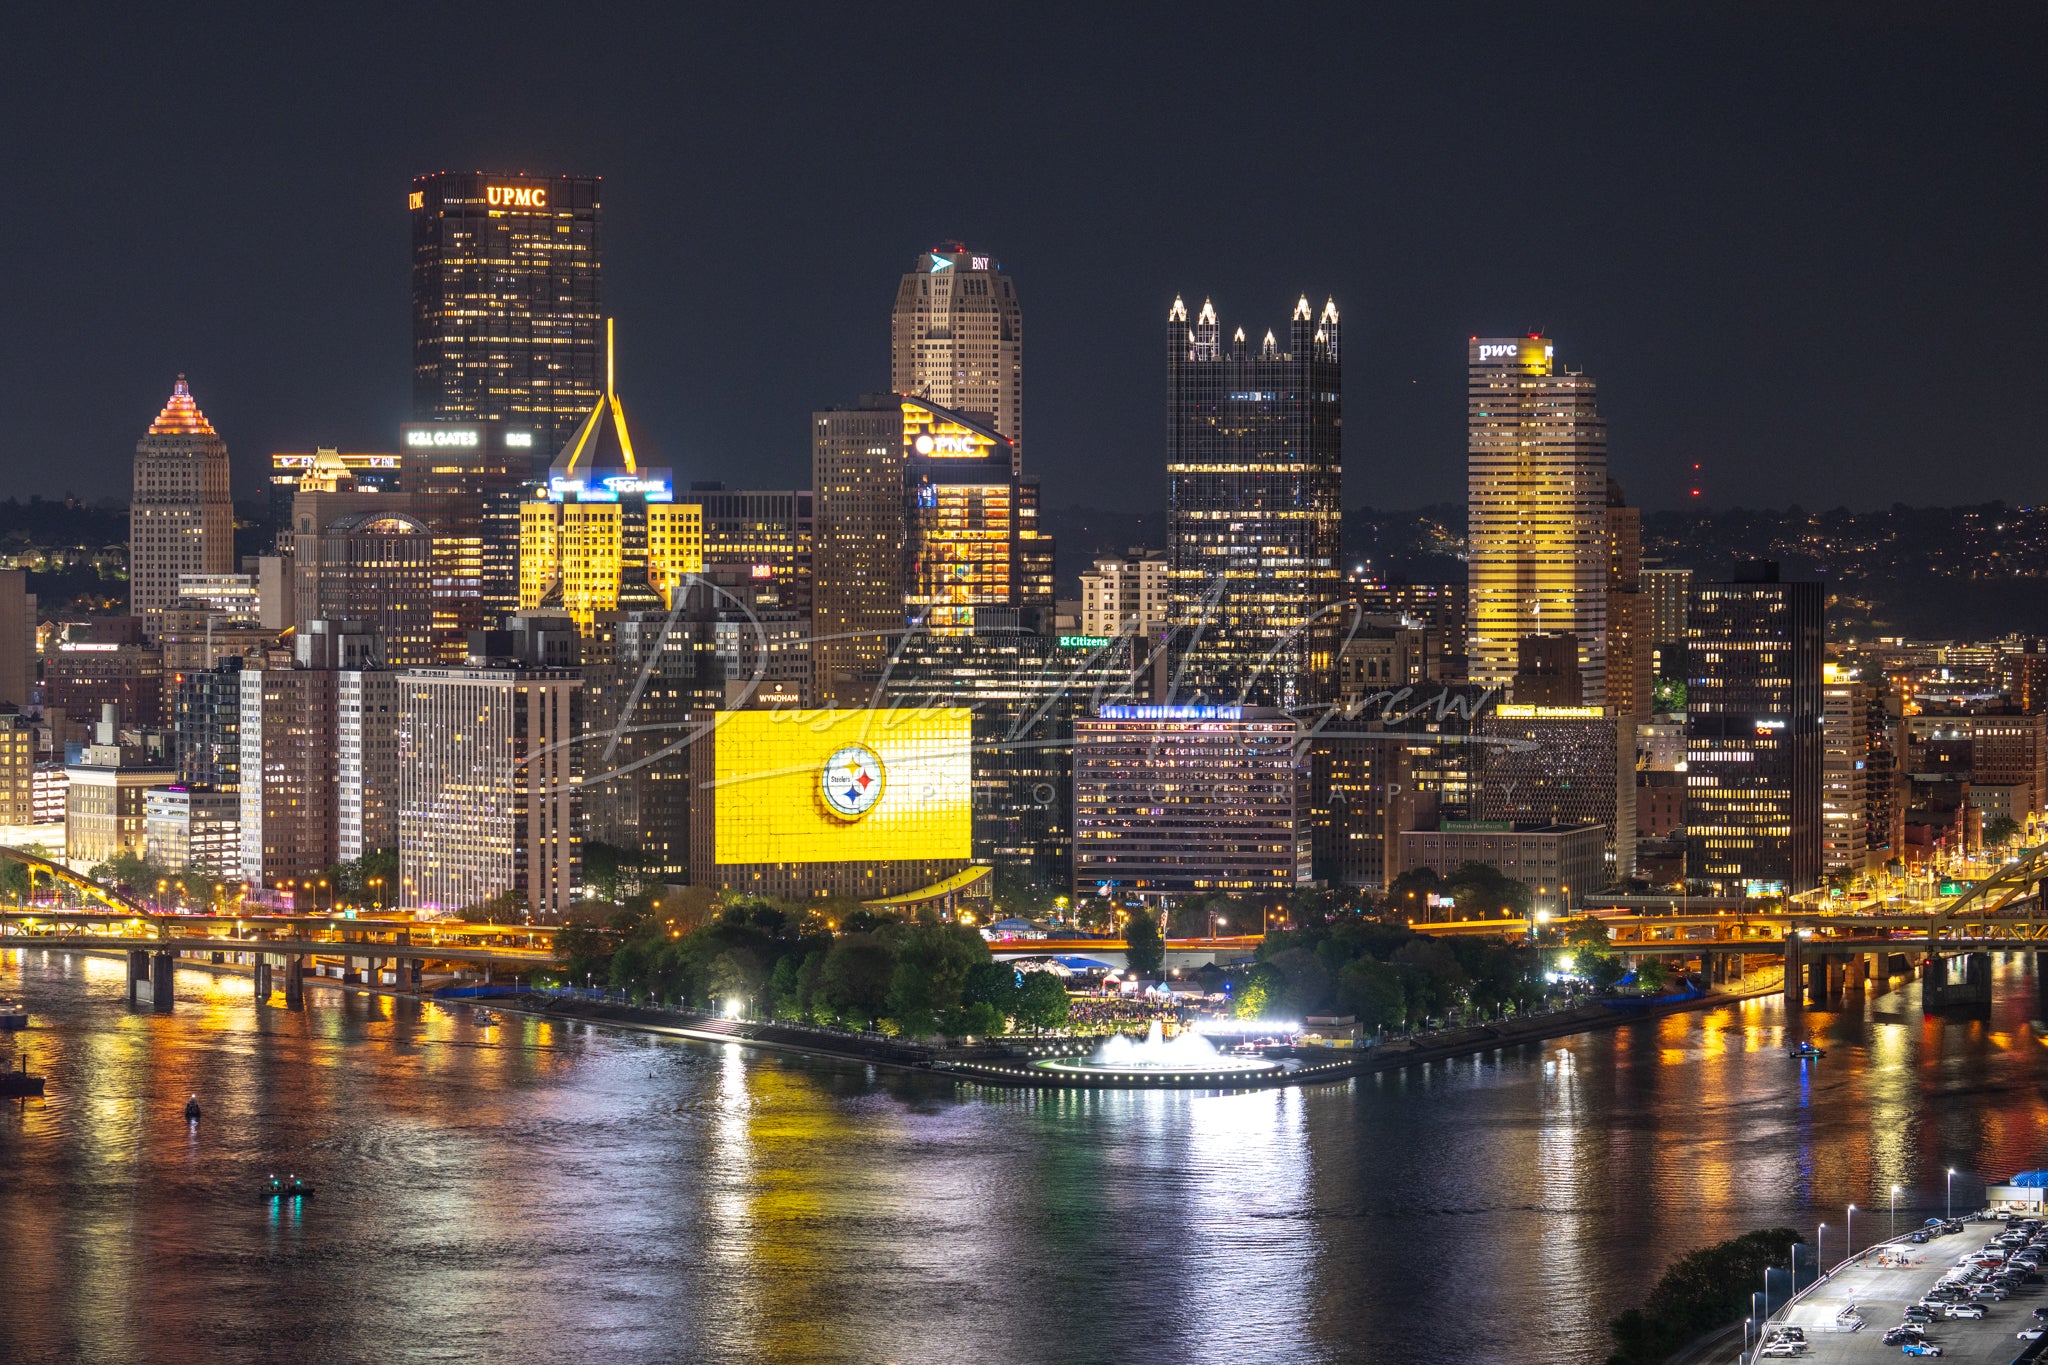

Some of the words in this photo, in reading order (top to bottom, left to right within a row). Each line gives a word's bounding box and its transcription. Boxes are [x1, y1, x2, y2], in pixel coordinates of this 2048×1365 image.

[408, 191, 424, 210] UPMC
[486, 186, 546, 207] UPMC
[972, 257, 989, 270] BNY
[1479, 344, 1517, 361] pwc
[434, 432, 477, 446] GATES
[935, 437, 975, 453] PNC
[381, 457, 394, 468] FNB
[1070, 636, 1108, 647] Citizens
[759, 694, 798, 702] WYNDHAM
[831, 775, 851, 783] Steelers
